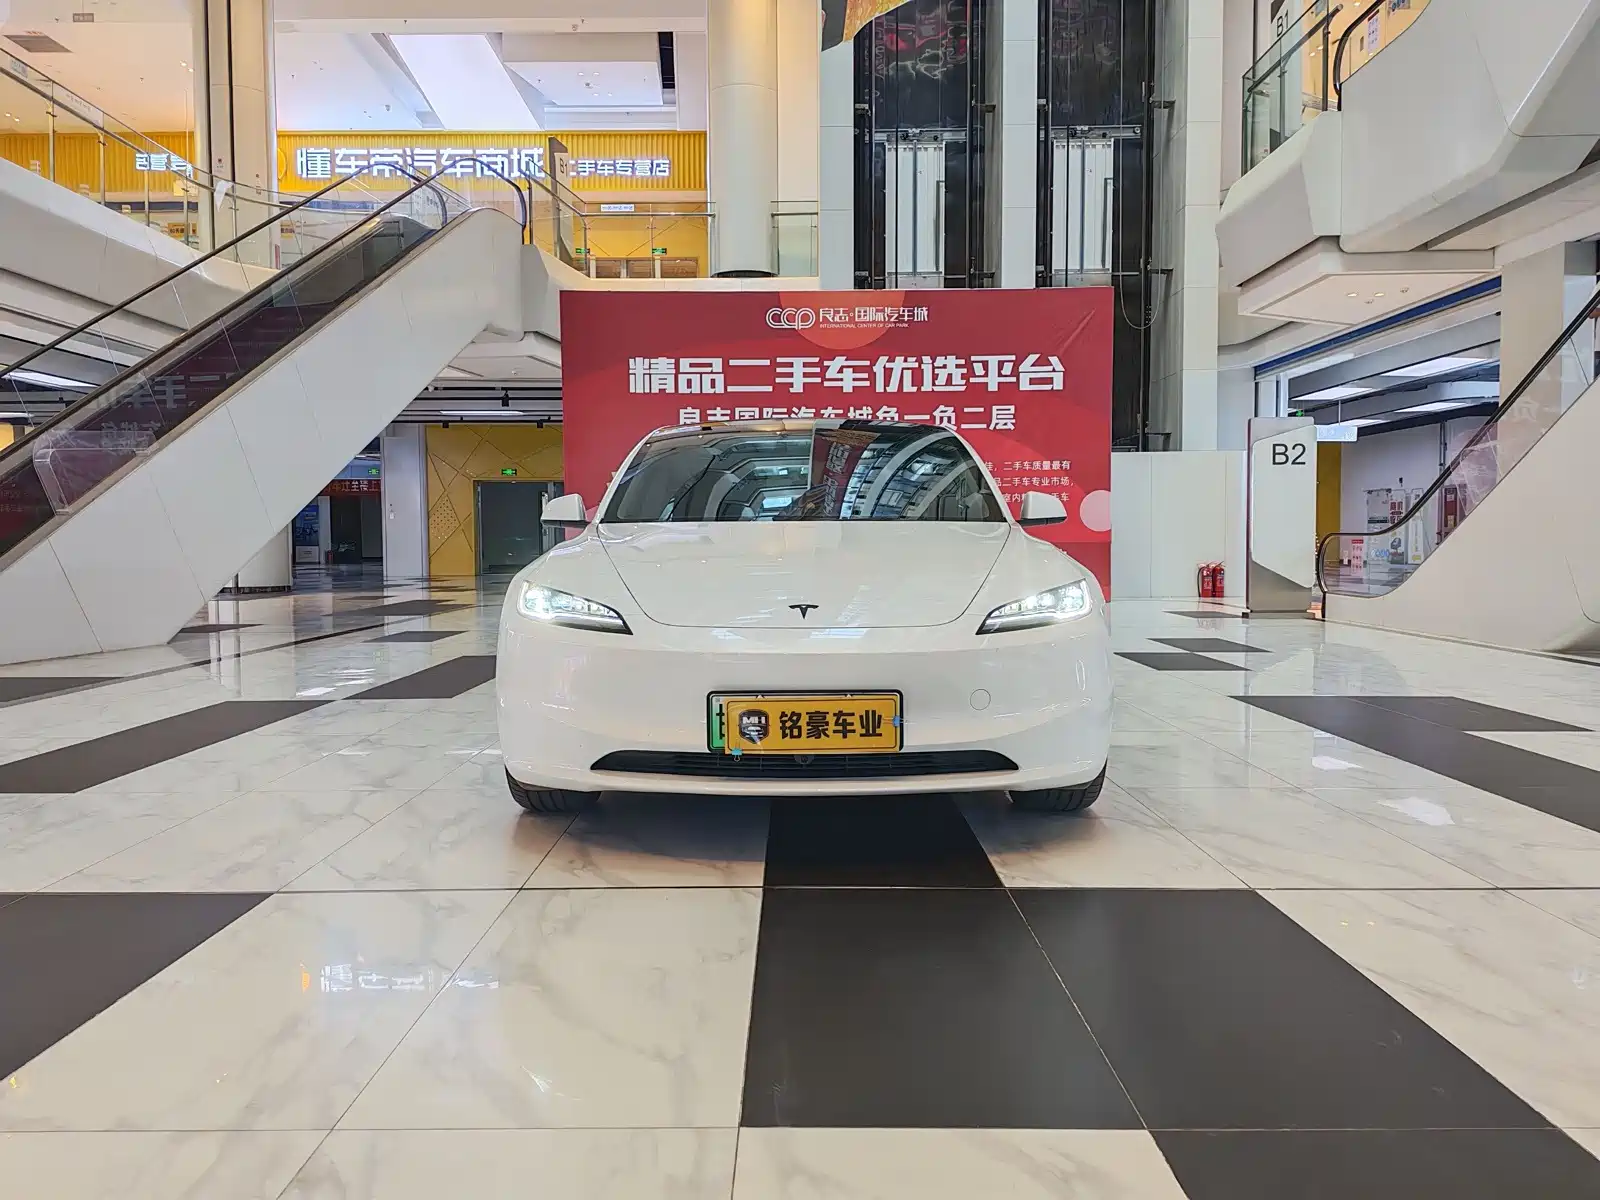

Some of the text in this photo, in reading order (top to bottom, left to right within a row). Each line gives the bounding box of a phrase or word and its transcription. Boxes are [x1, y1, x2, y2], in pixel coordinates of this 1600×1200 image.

[628, 353, 1066, 394] 精品二手车优选平台
[1271, 443, 1307, 466] B2
[779, 709, 883, 740] 铭豪车业
